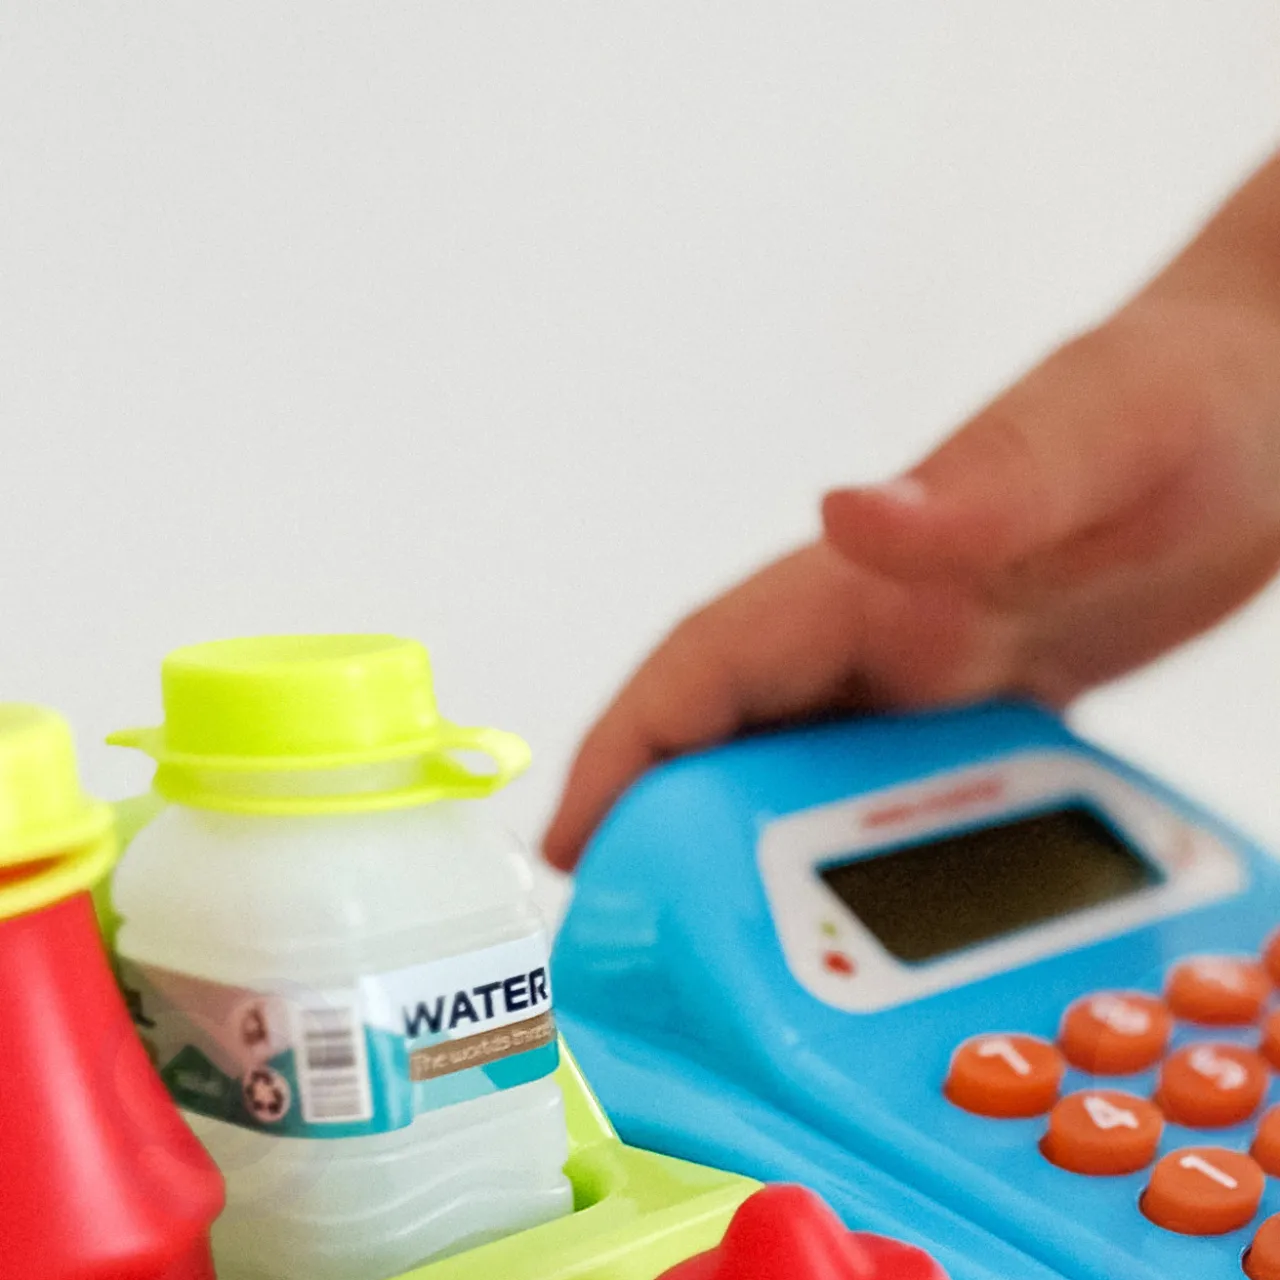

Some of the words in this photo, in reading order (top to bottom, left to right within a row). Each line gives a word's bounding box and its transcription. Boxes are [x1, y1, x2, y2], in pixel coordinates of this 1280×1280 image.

[402, 967, 548, 1038] WATER
[978, 1036, 1031, 1075] 7
[1189, 1046, 1247, 1091] 5
[1083, 1096, 1139, 1130] 4
[1179, 1155, 1238, 1190] 1
